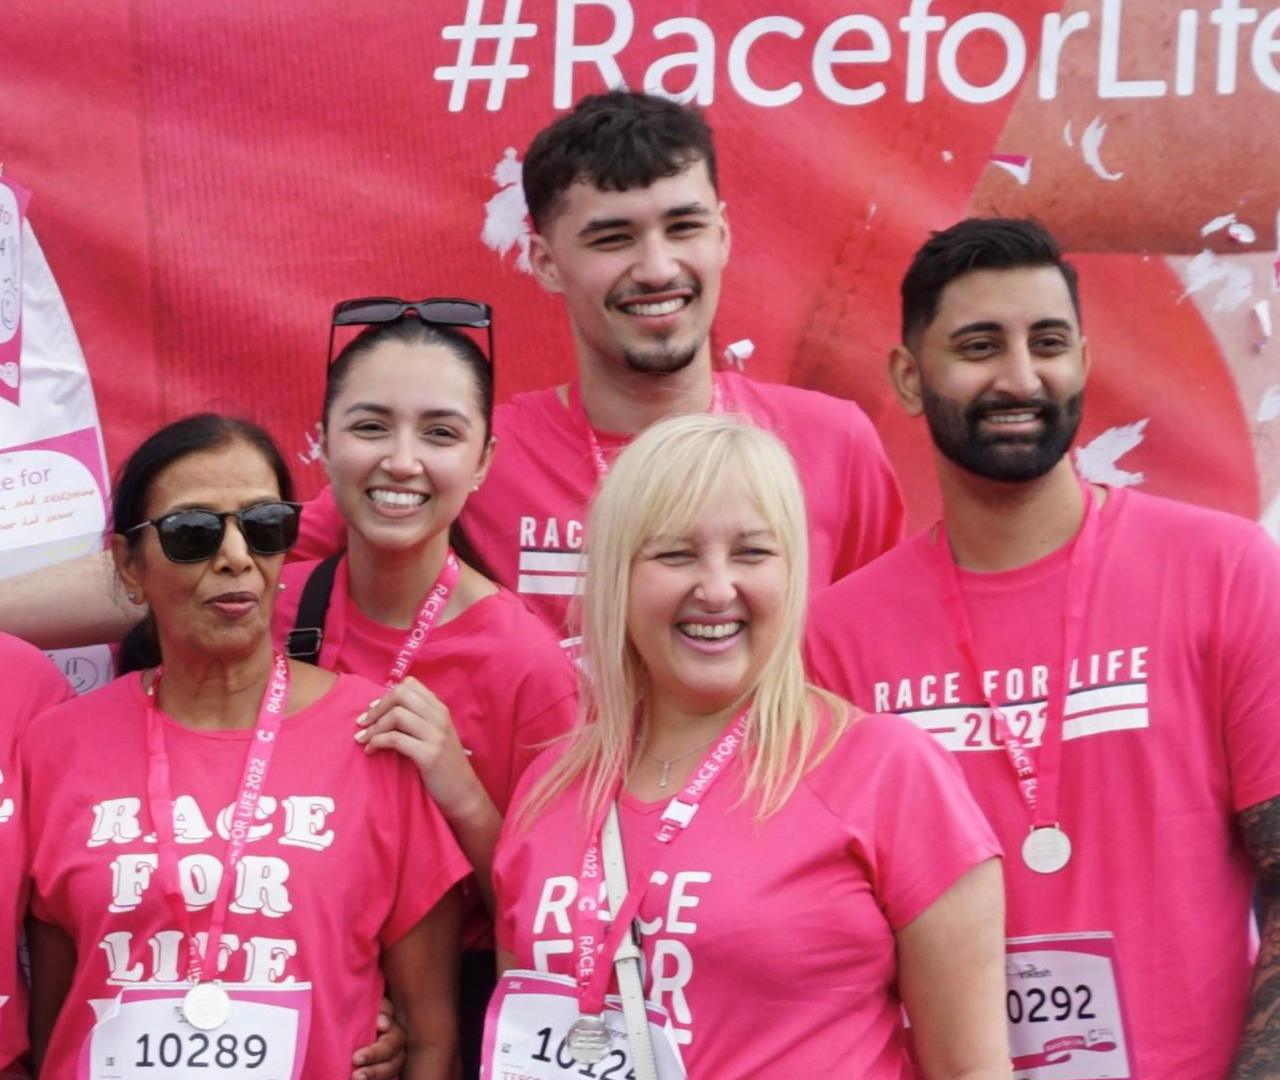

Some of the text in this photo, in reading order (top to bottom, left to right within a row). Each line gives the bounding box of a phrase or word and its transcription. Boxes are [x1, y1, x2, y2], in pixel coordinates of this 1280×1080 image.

[20, 467, 52, 487] for
[518, 516, 584, 549] RAC
[420, 582, 449, 620] RACE
[405, 619, 430, 649] FOR
[390, 648, 413, 679] LIFE
[874, 647, 1149, 713] RACE FOR LIFE
[266, 680, 287, 714] RACE
[244, 757, 266, 790] 2022
[685, 760, 720, 797] RACE
[711, 734, 740, 762] FOR
[1007, 739, 1033, 777] RACE
[241, 789, 258, 819] LIFE
[86, 794, 336, 852] RACE
[581, 847, 598, 879] 2022
[107, 853, 293, 918] FOR
[99, 931, 298, 986] LIFE
[578, 935, 594, 981] RACE
[135, 1032, 268, 1069] 10289
